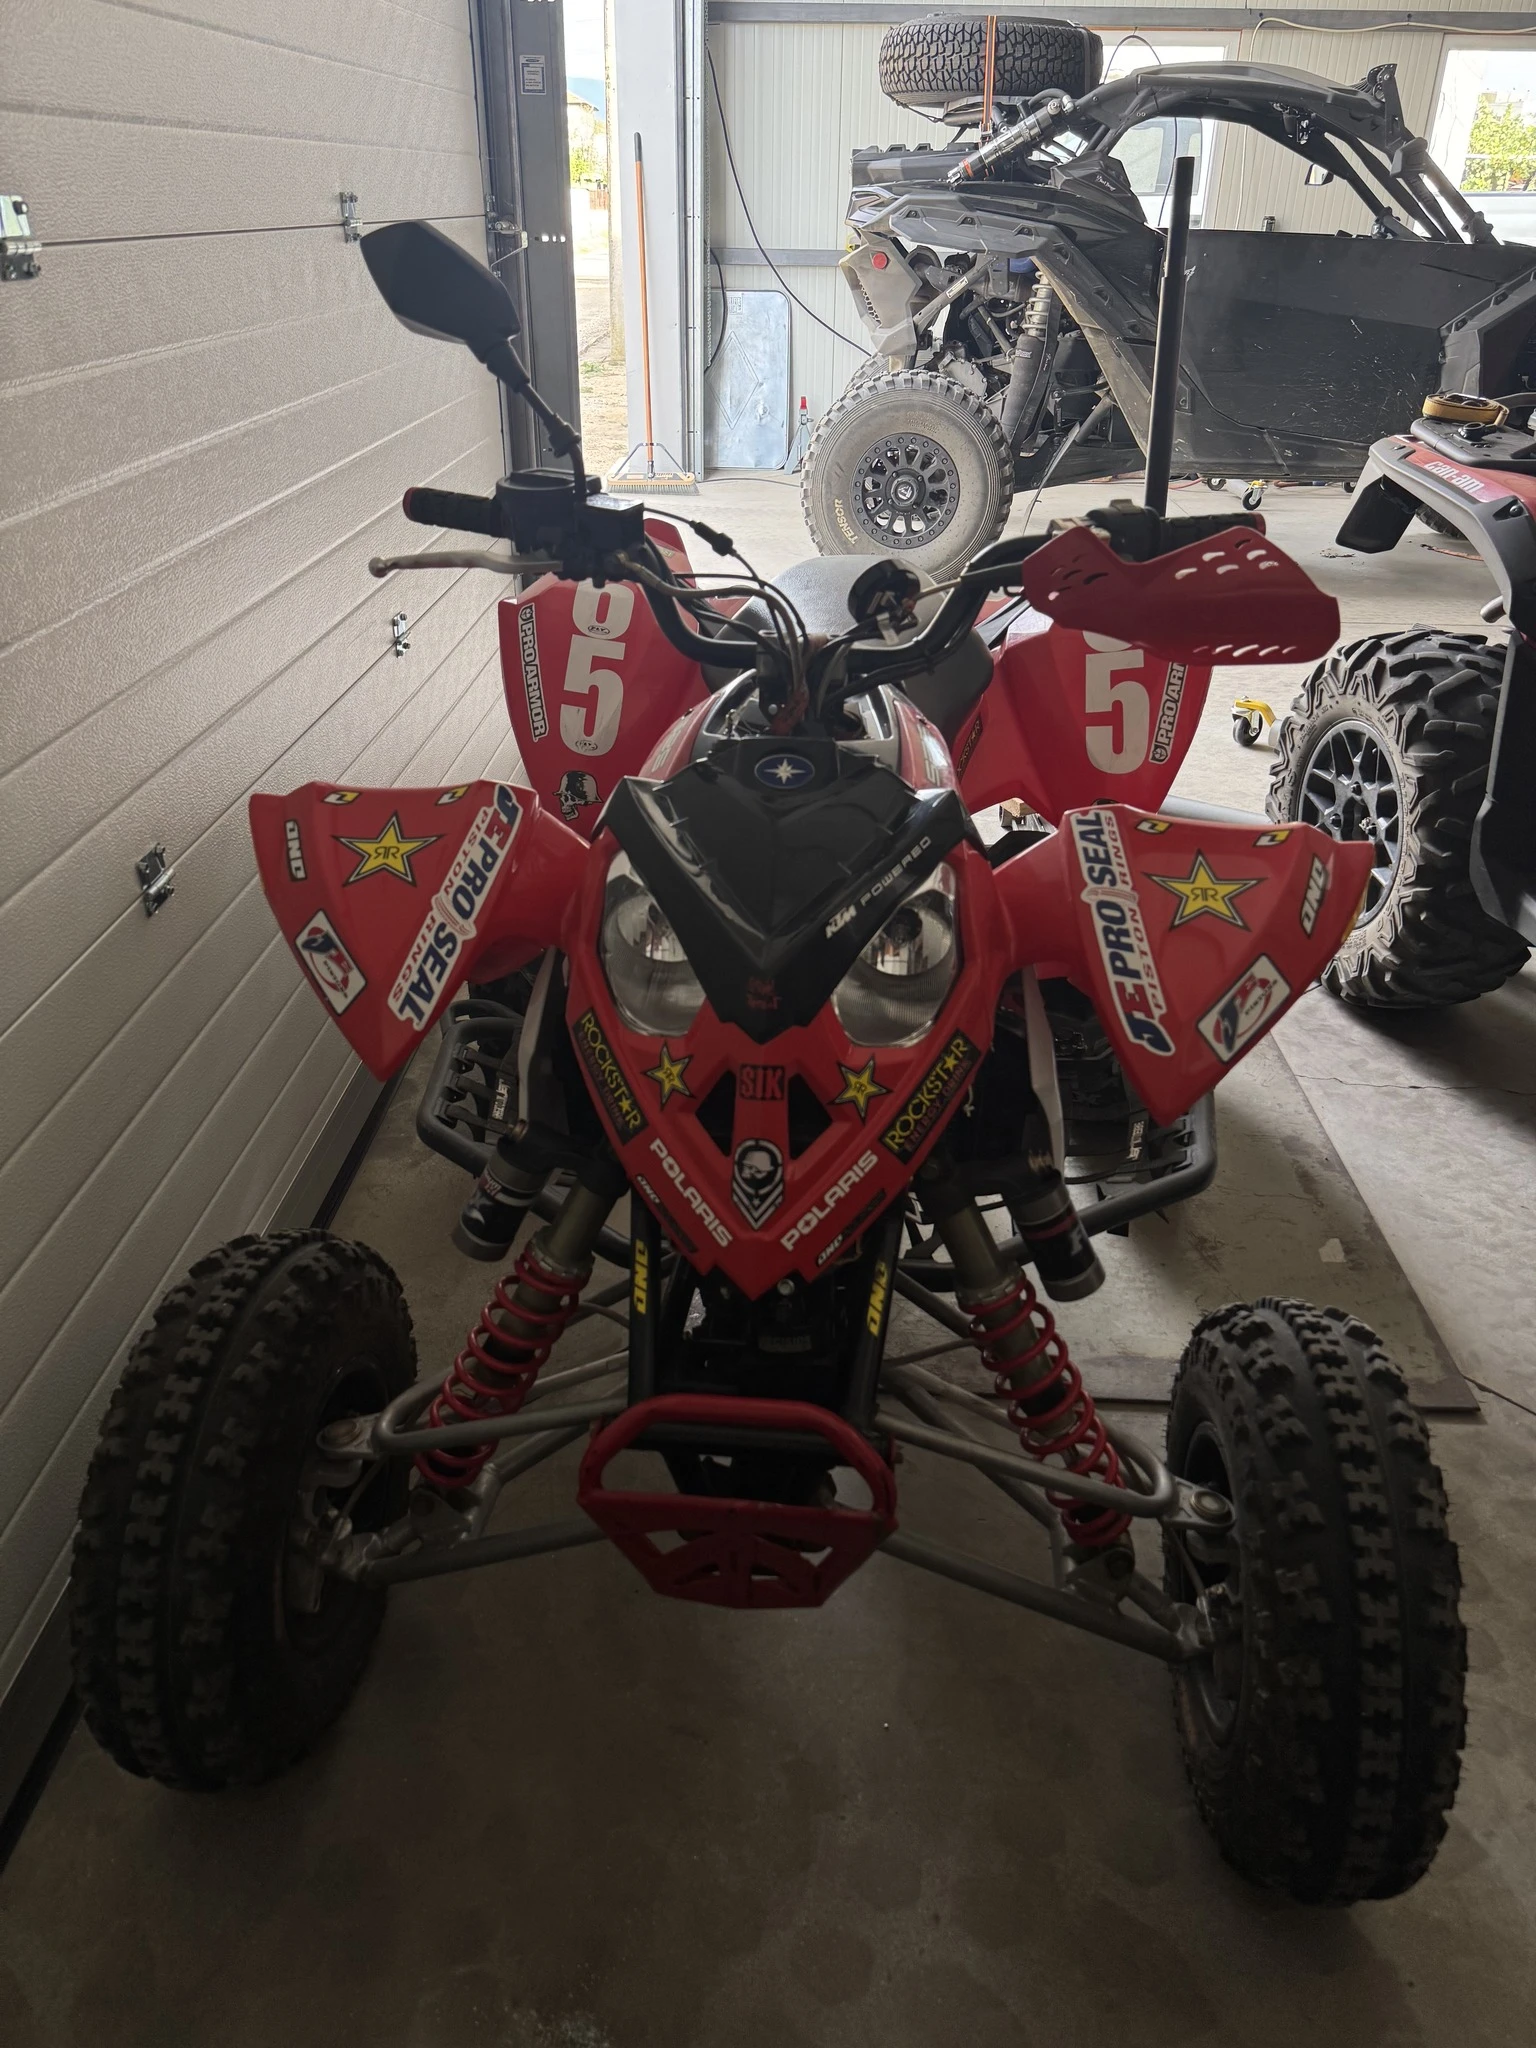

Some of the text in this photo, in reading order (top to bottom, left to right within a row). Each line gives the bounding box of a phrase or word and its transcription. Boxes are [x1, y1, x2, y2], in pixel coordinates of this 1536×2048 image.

[834, 498, 860, 545] TENSOR
[560, 634, 626, 757] 5
[1085, 649, 1150, 774] 5
[451, 838, 501, 921] PRO
[825, 836, 932, 939] KTM POWERED
[1083, 811, 1117, 888] SEAL
[391, 809, 489, 1002] PISTON RINGS
[1096, 900, 1142, 981] PRO
[1103, 815, 1165, 1013] PISTON RINGS
[397, 921, 459, 1027] SEAL
[649, 1137, 734, 1249] POLARIS
[779, 1148, 880, 1253] POLARIS
